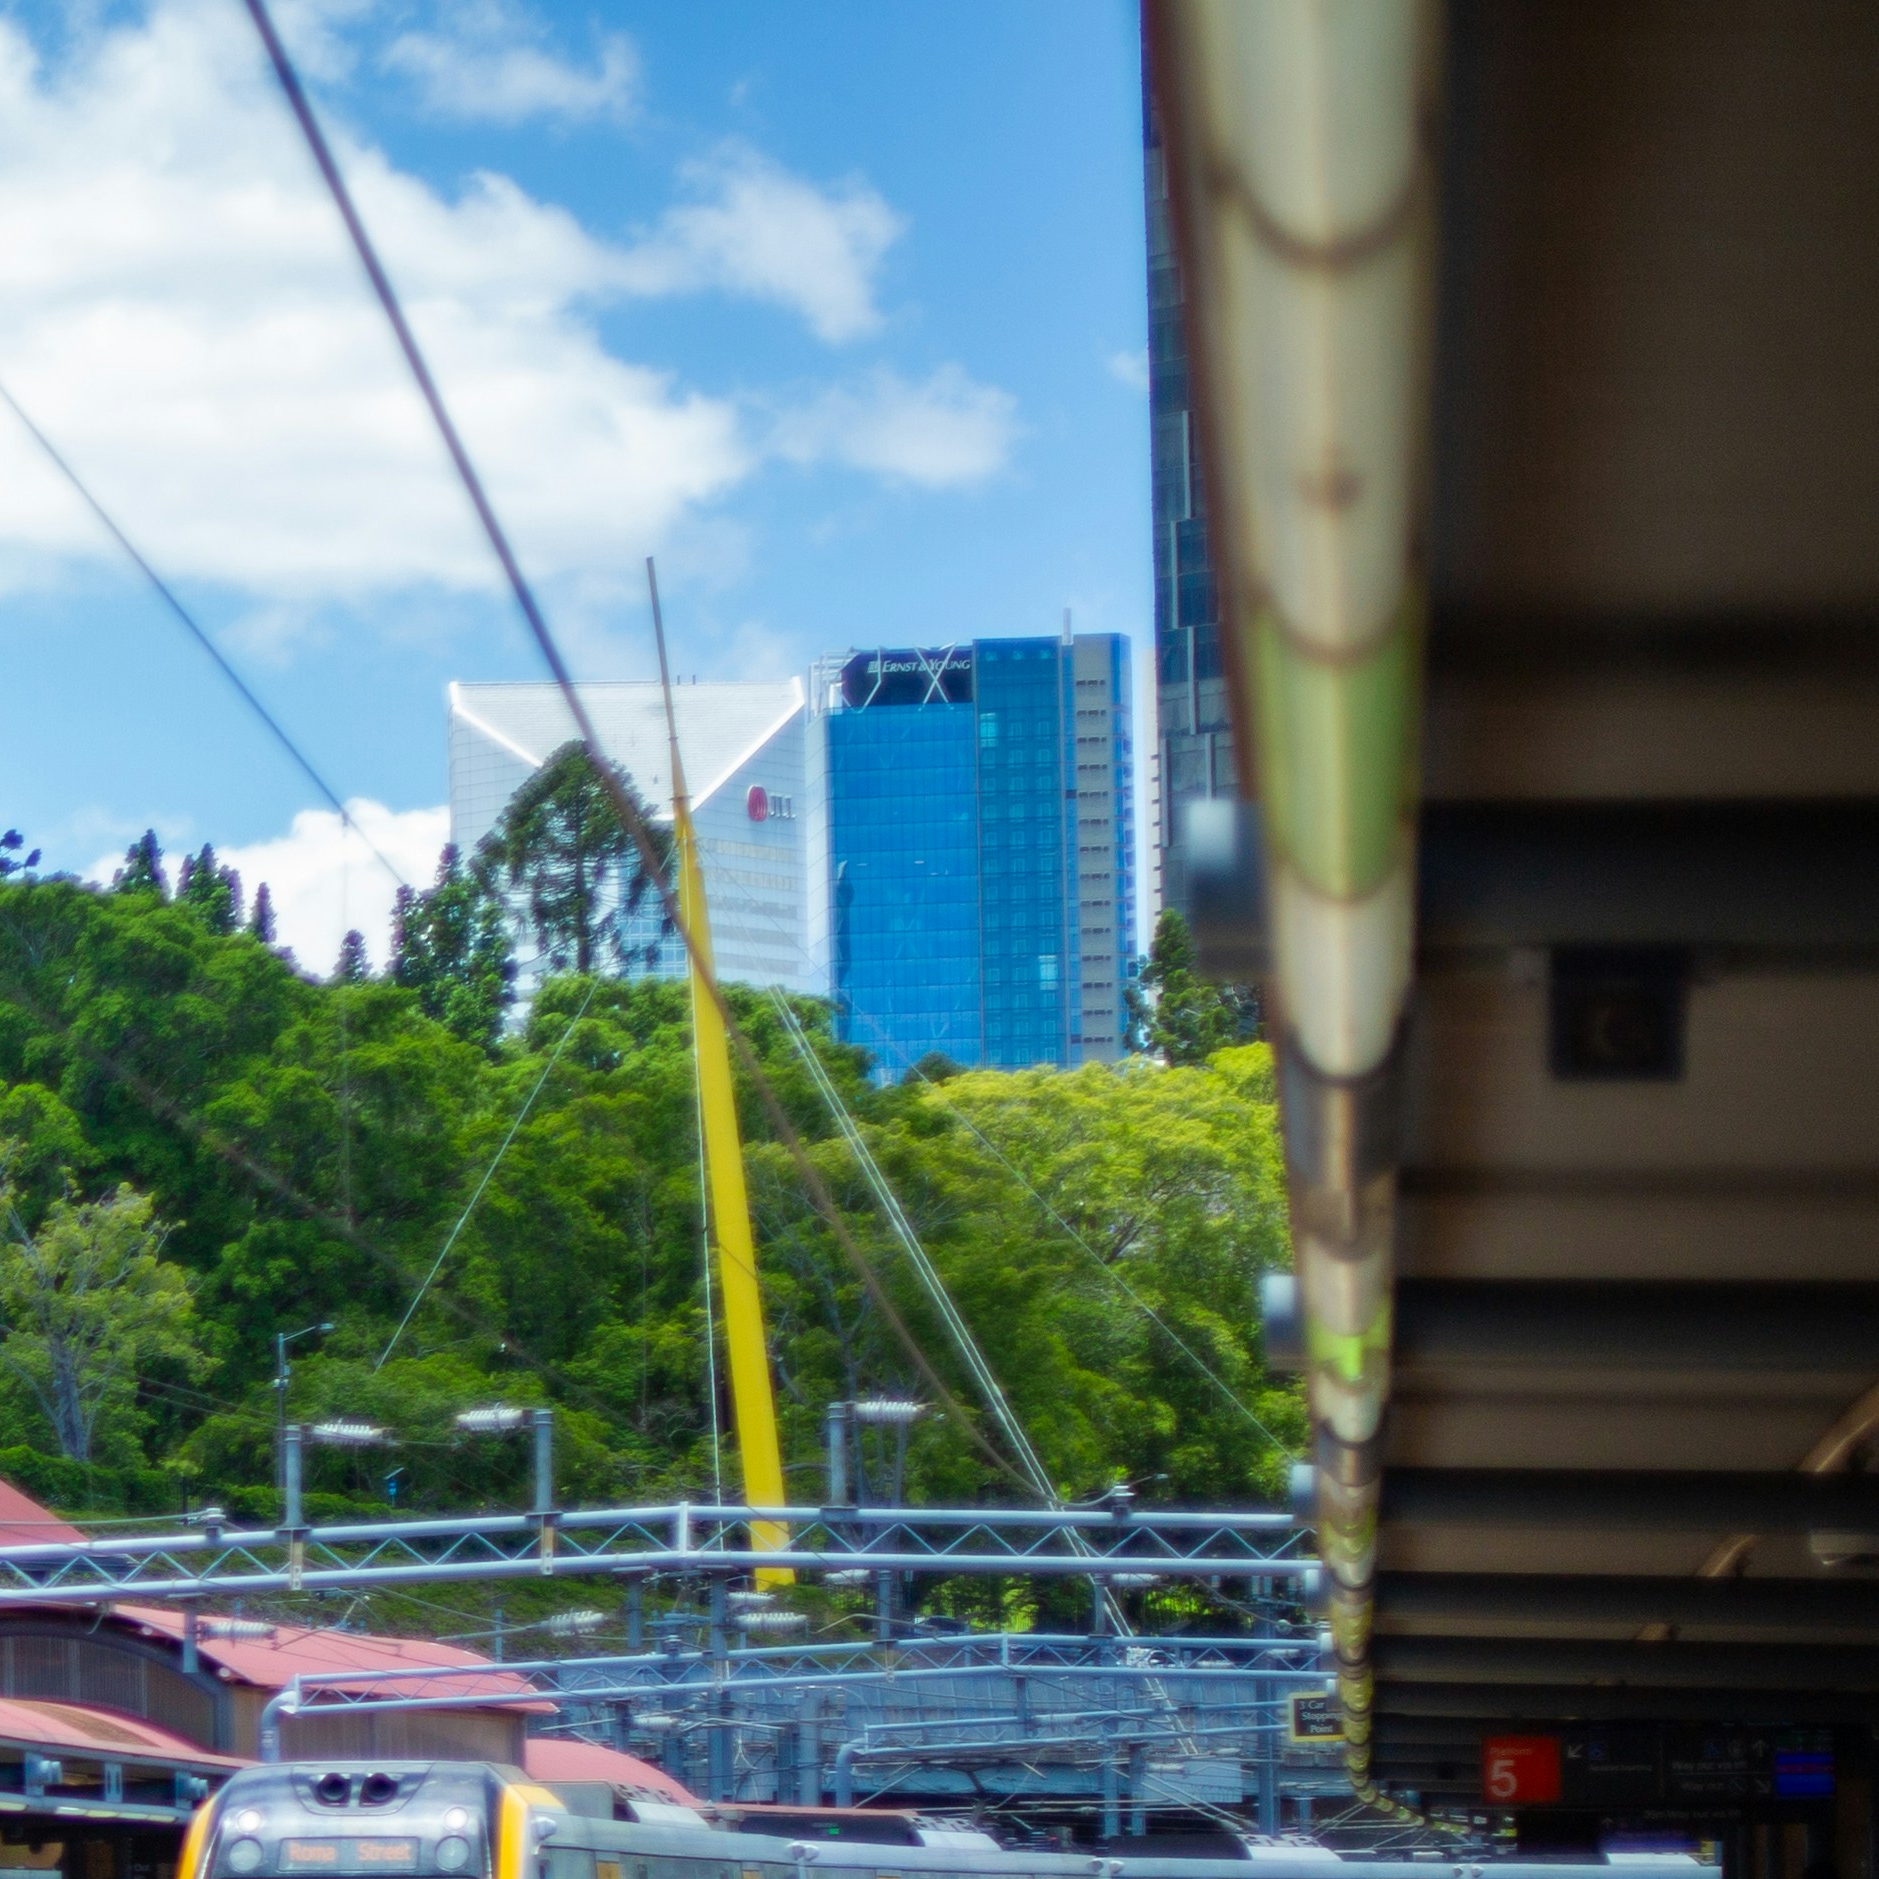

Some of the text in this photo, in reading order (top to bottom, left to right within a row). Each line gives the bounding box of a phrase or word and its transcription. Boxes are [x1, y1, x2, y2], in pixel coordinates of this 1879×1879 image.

[882, 660, 919, 673] ERNST
[928, 658, 971, 671] YOUNG
[769, 792, 796, 818] JLL
[1490, 1759, 1518, 1797] 5
[289, 1842, 411, 1862] Roma Street
